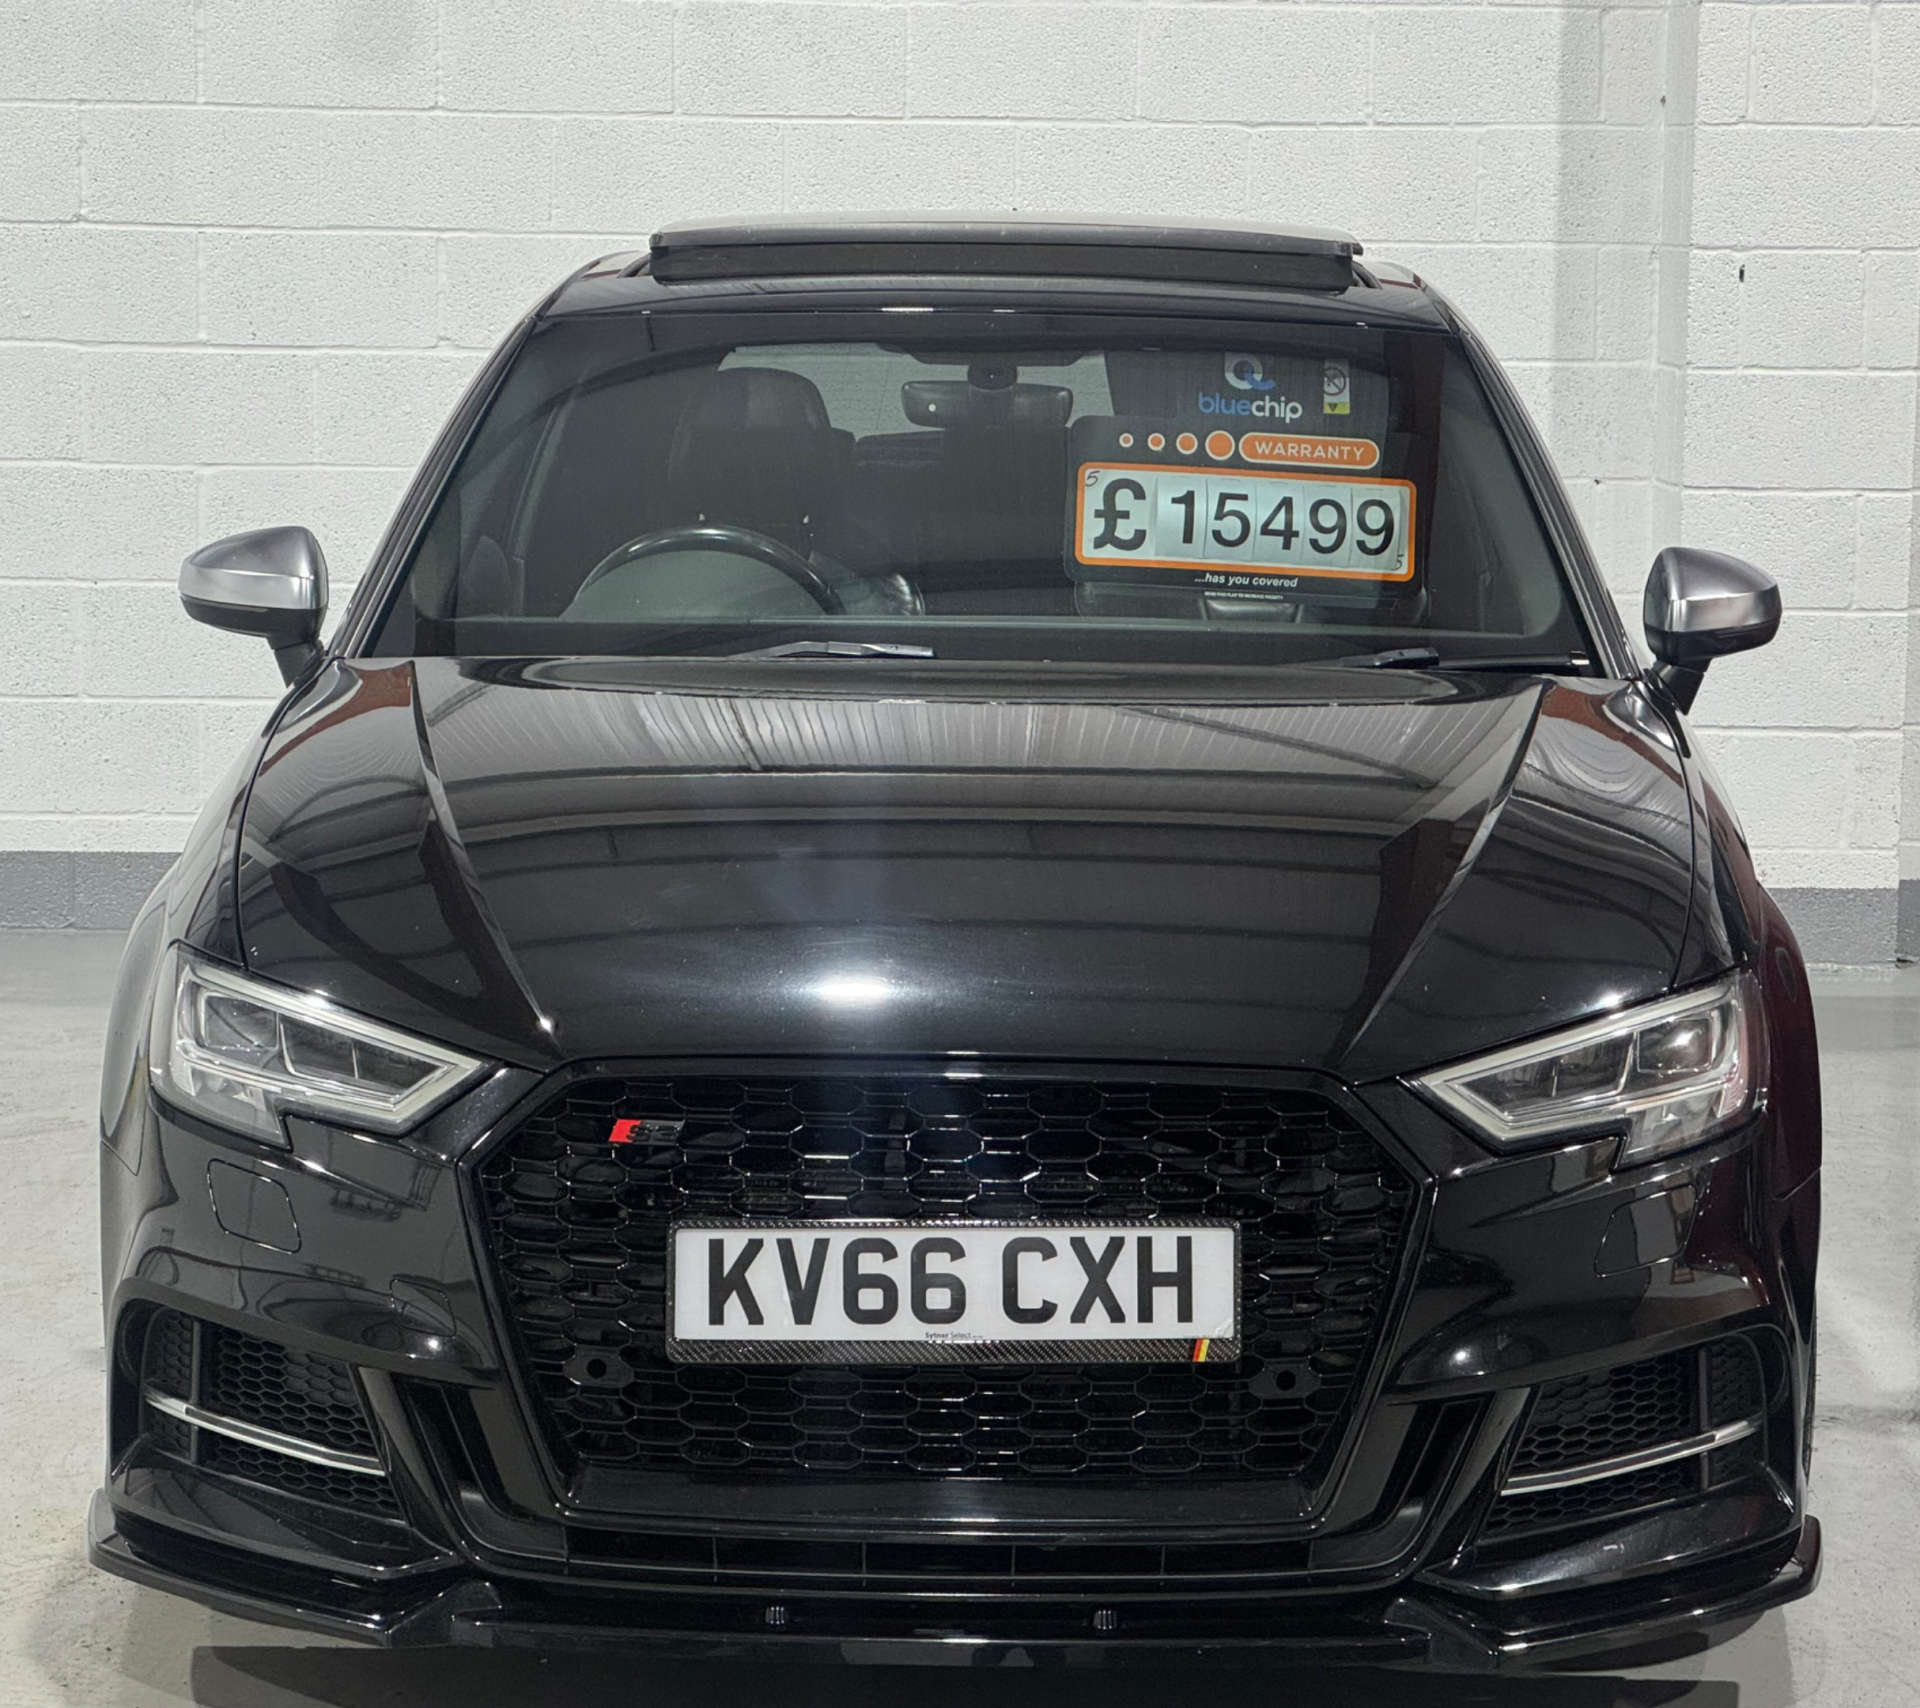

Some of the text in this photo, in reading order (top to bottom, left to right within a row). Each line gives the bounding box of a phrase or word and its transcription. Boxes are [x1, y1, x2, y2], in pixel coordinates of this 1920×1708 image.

[1198, 392, 1303, 424] bluechip
[1255, 441, 1365, 461] WARRANTY
[1093, 478, 1395, 556] £15499
[1228, 576, 1250, 587] you
[1252, 577, 1299, 588] covered
[708, 1235, 1193, 1326] KV66 CXH
